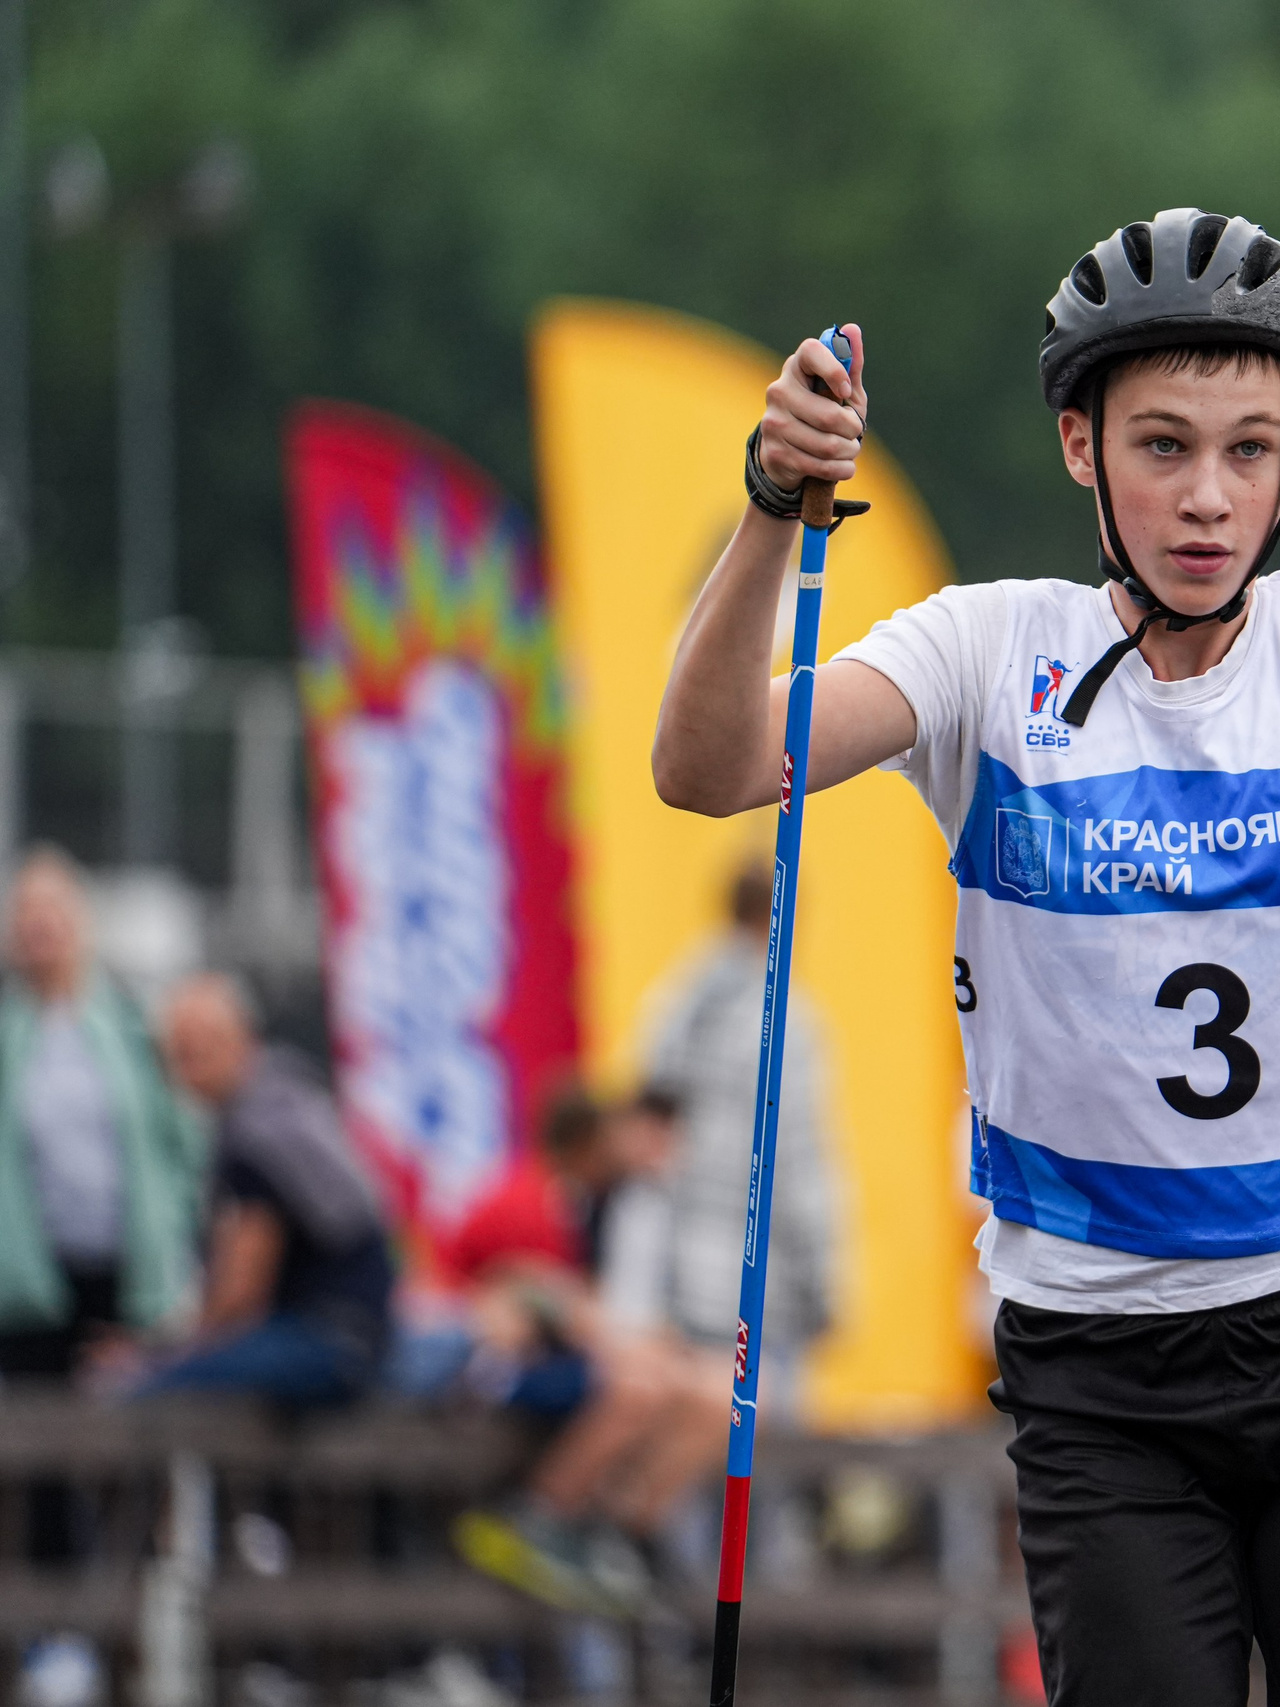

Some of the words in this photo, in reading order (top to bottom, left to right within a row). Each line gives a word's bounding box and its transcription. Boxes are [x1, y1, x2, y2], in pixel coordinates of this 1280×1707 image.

[1026, 732, 1071, 748] СБР
[1082, 856, 1192, 894] КРАЙ
[768, 914, 778, 973] ELITE
[774, 869, 782, 909] PRO
[954, 955, 977, 1012] 3
[762, 1010, 771, 1047] CARBON
[1154, 963, 1261, 1120] 3
[749, 1153, 758, 1211] ELITE
[746, 1216, 754, 1256] PRO
